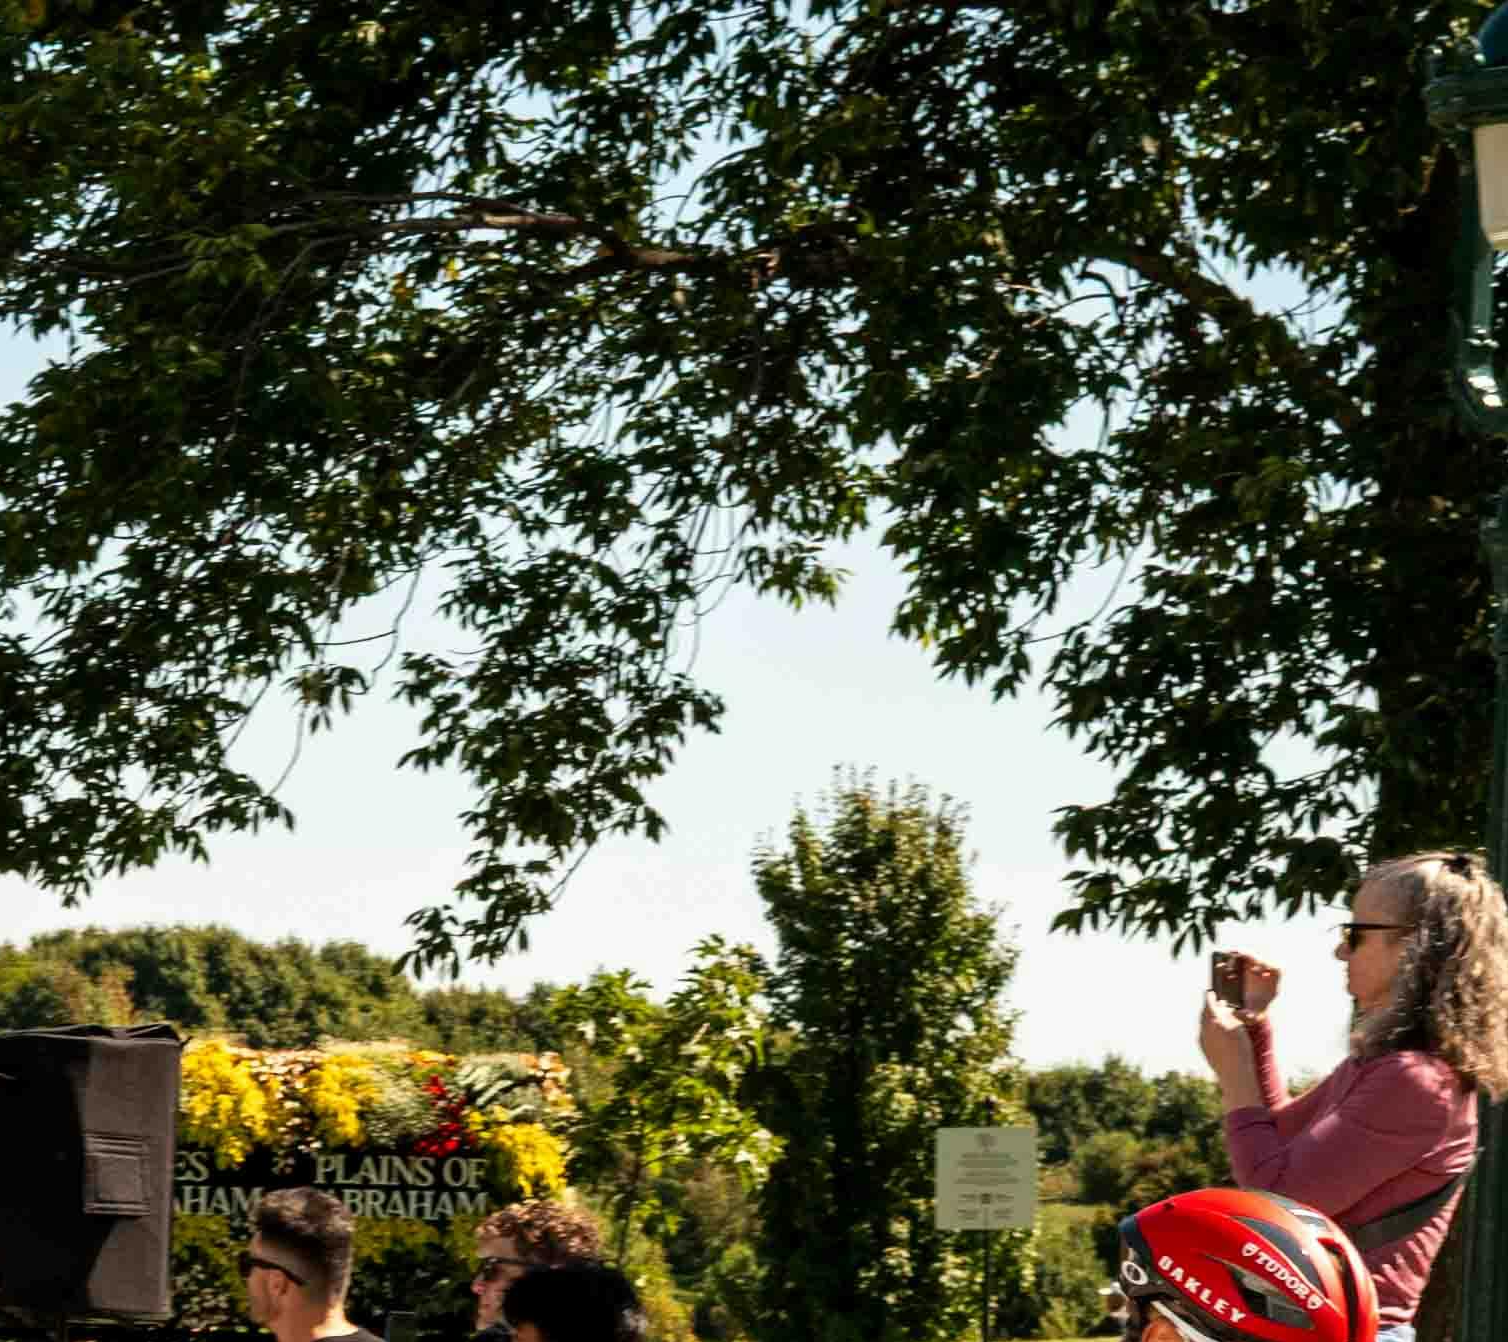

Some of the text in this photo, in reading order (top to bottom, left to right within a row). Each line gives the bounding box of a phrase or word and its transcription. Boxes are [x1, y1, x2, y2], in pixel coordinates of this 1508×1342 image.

[313, 1152, 435, 1185] PLAINS
[443, 1157, 489, 1187] OF
[342, 1188, 489, 1220] BRAHAM
[1157, 1255, 1246, 1324] OAKLEY
[1254, 1251, 1311, 1301] TUDOR
